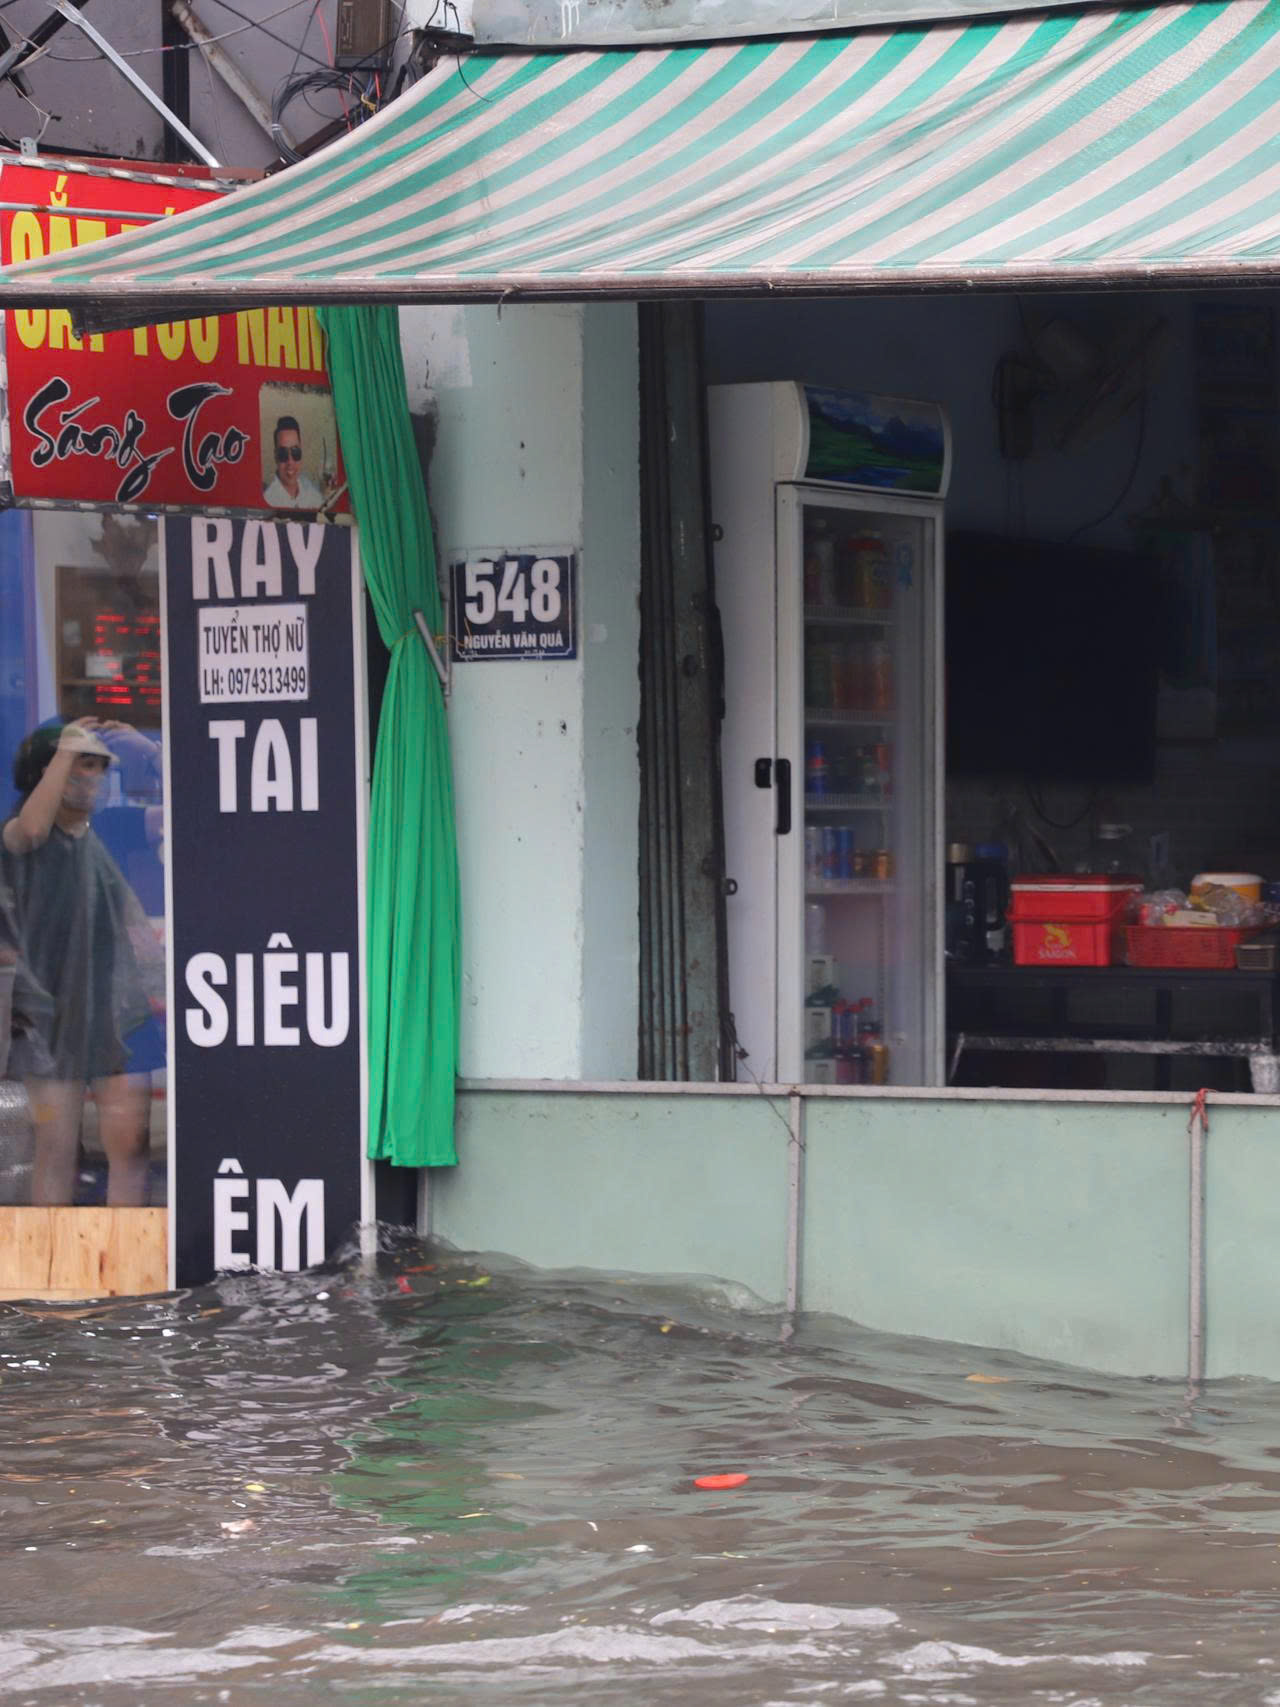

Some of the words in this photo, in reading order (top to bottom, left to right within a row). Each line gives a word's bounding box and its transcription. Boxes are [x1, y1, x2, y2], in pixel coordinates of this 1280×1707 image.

[24, 376, 174, 502] Sáng
[465, 559, 561, 624] 548
[204, 610, 248, 655] TUYỂN
[252, 620, 281, 659] THỢ
[513, 631, 537, 647] VĂN
[540, 630, 563, 647] QUÁ
[204, 669, 223, 695] LH:
[228, 666, 306, 695] 0974313499
[209, 718, 319, 812] TAI
[185, 933, 349, 1047] SIÊU
[213, 1158, 326, 1273] ÊM
